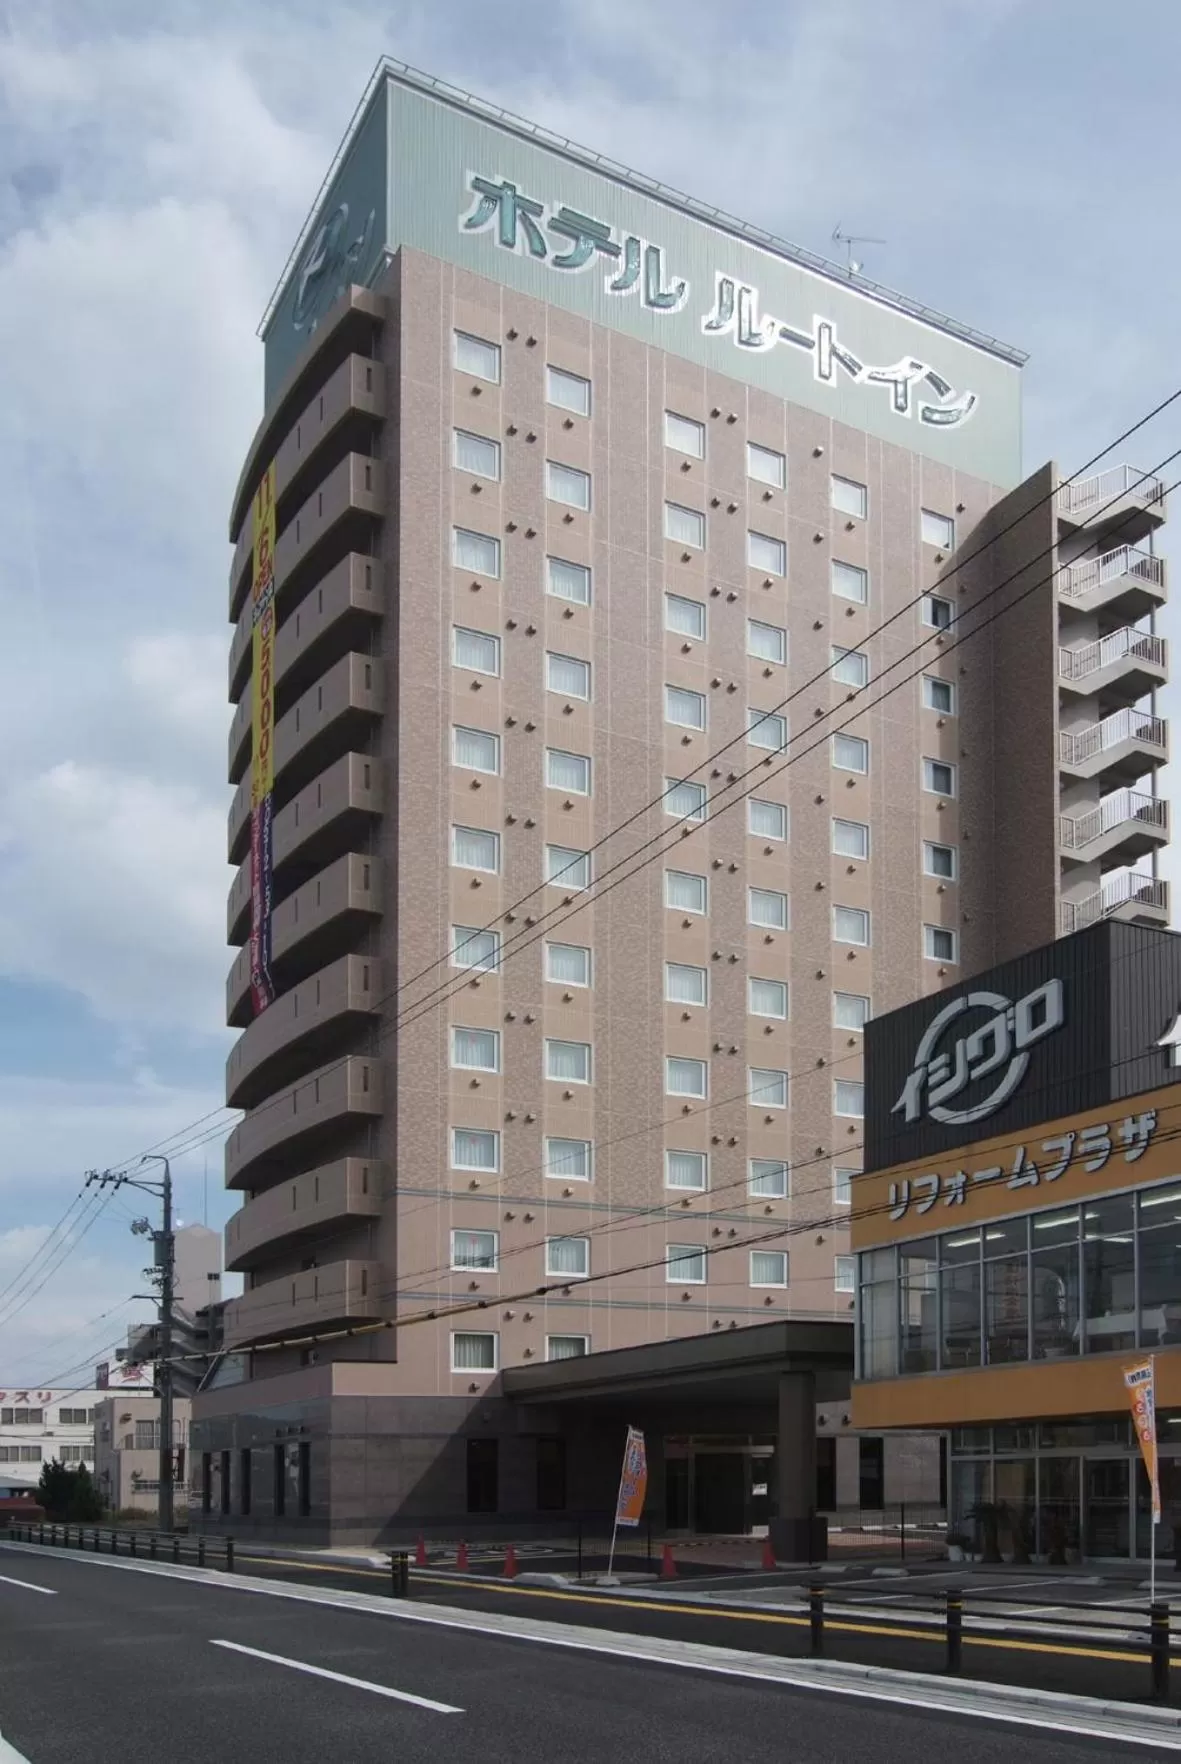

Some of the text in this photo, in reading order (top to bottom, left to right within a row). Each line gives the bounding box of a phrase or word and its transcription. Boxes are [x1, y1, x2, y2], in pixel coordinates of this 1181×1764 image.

[458, 170, 689, 314] ホテル
[702, 270, 980, 429] ルートイン
[891, 978, 1066, 1122] イシグロ
[888, 1108, 1158, 1221] リフォームプラザ
